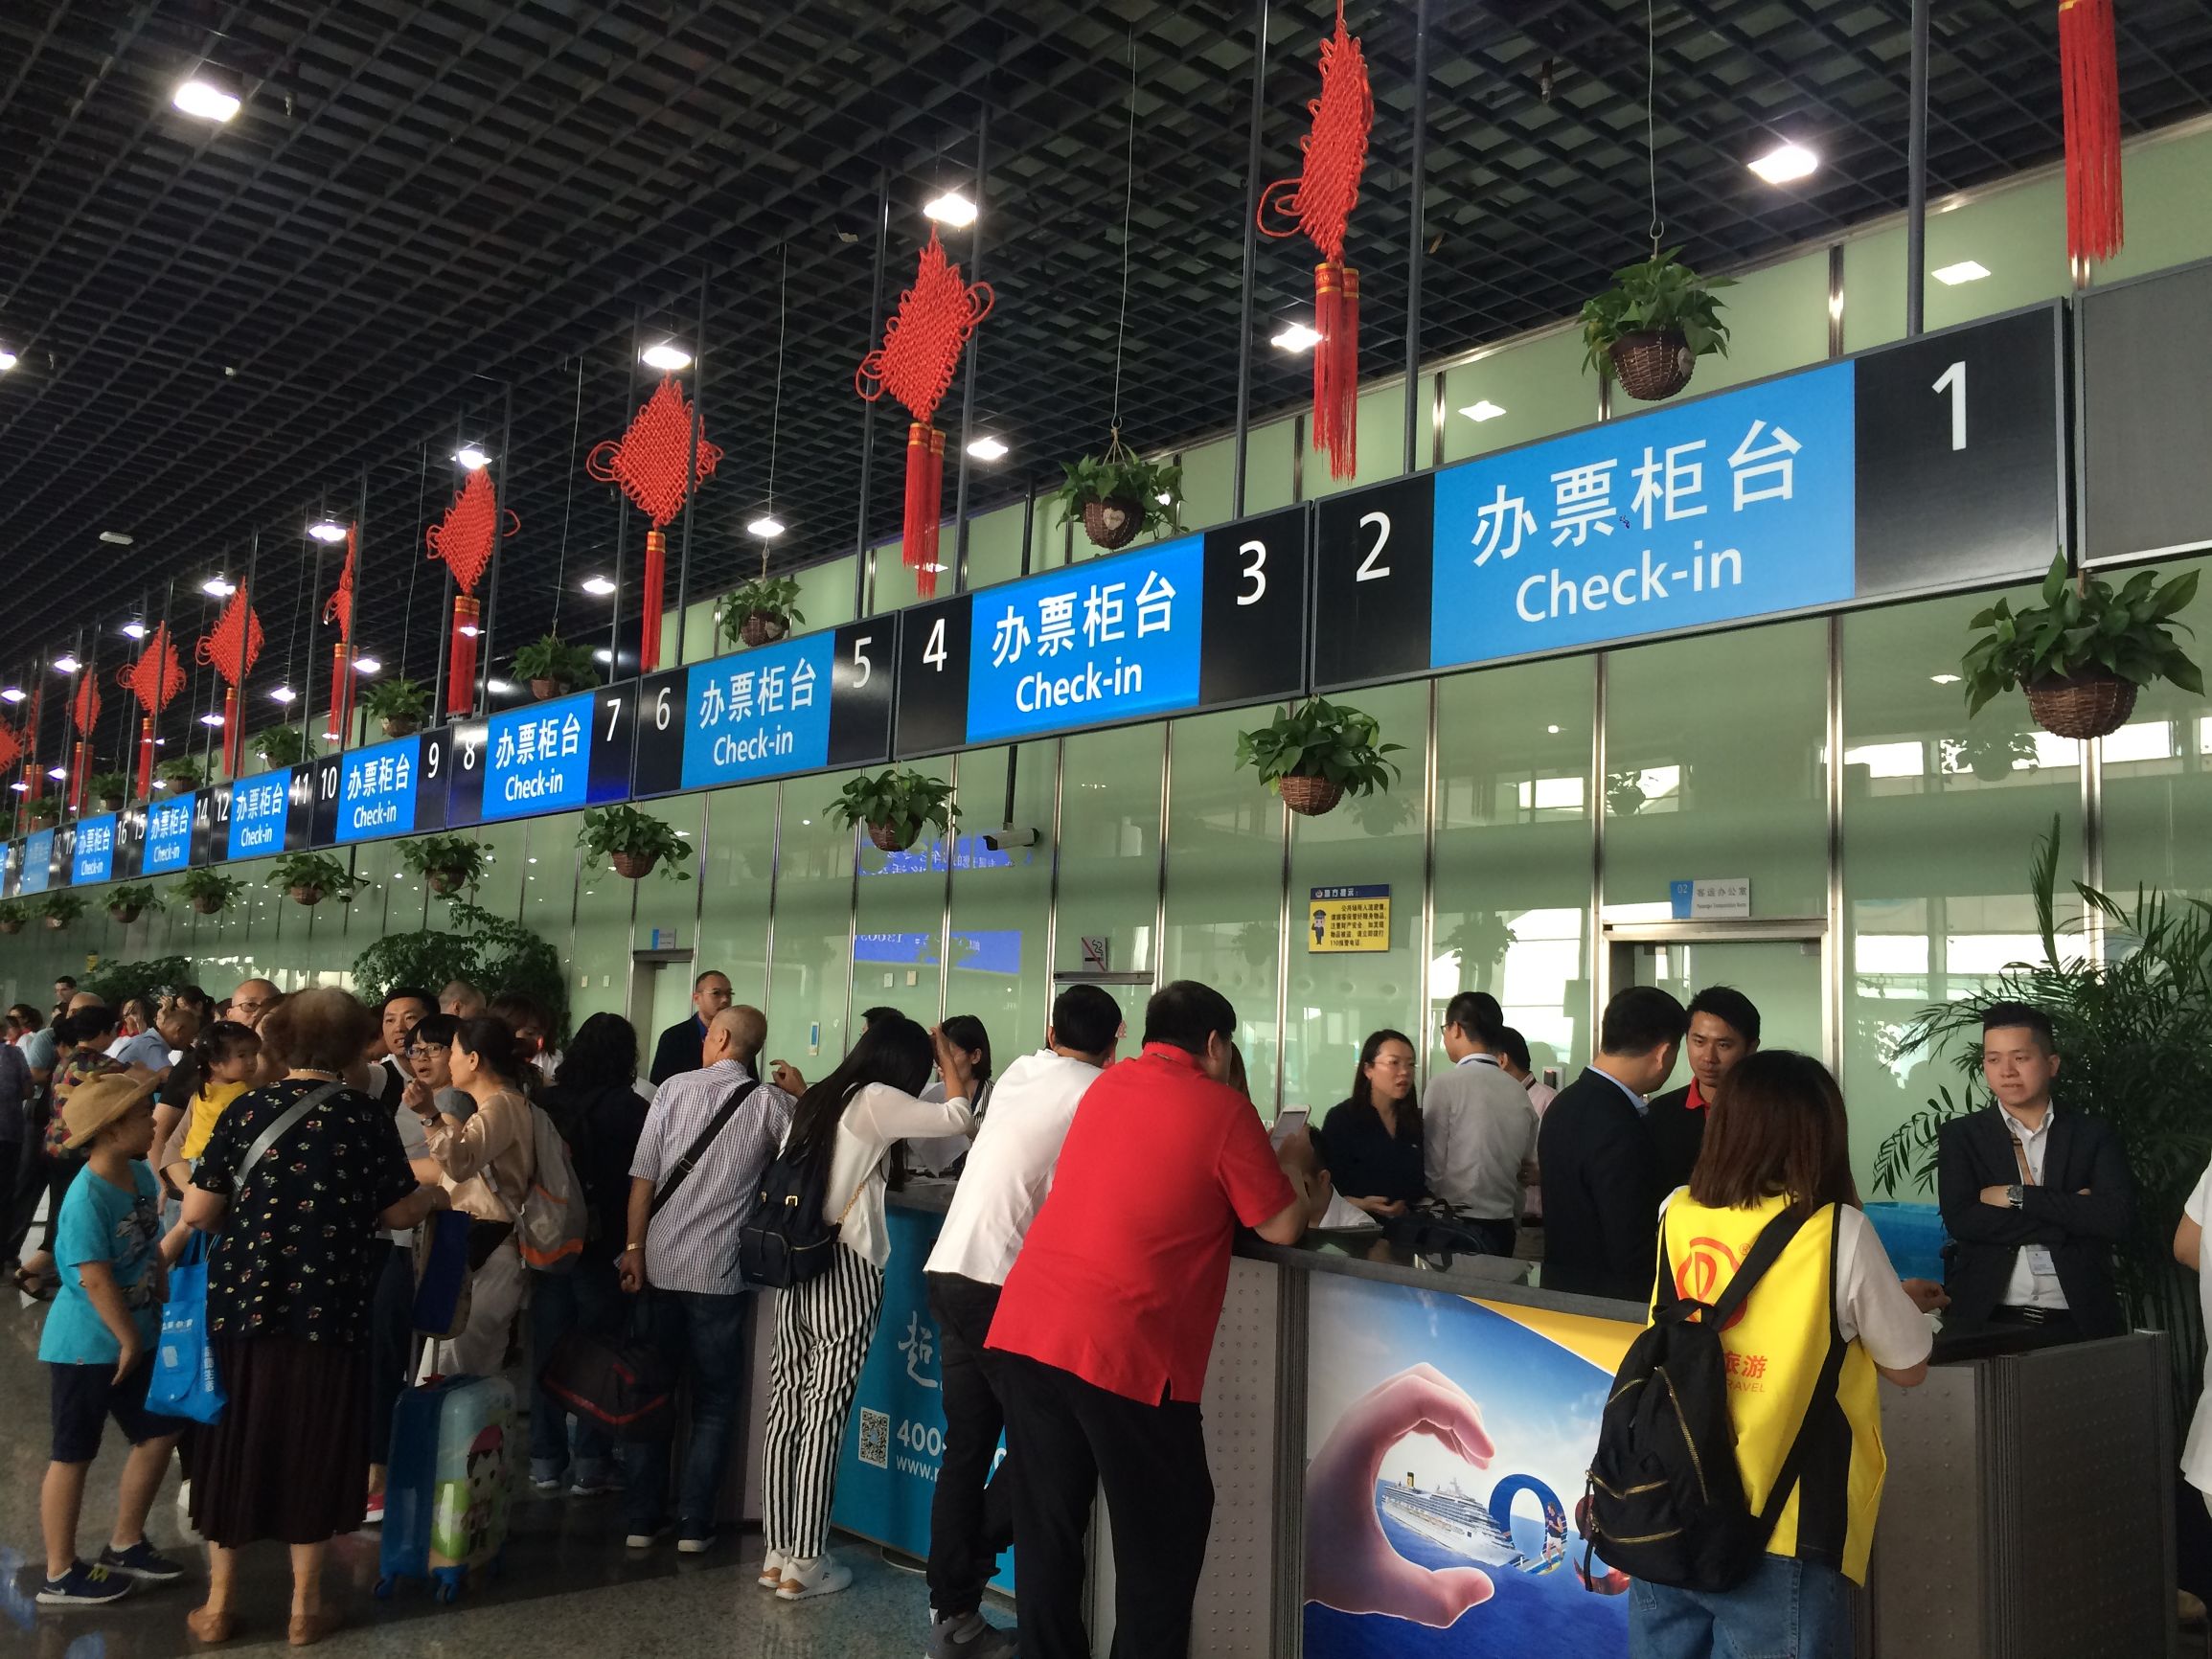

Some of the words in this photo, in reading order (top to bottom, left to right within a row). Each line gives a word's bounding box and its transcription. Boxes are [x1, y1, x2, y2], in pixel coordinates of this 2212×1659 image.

[1931, 360, 1967, 450] 1
[1471, 420, 1802, 567] 办票柜台
[1356, 511, 1390, 582] 2
[1237, 540, 1266, 605] 3
[1516, 539, 1744, 623] Check-in
[992, 571, 1176, 667] 办票柜台
[852, 637, 873, 689] 5
[923, 618, 947, 671] 4
[699, 658, 816, 729] 办票柜台
[1015, 656, 1142, 713] Check-in
[606, 697, 622, 742] 7
[655, 687, 672, 731] 6
[427, 741, 440, 779] 9
[464, 735, 476, 770] 8
[495, 713, 581, 769] 办票柜台
[714, 725, 793, 766] Check-in
[293, 772, 309, 807] 11
[321, 765, 337, 801] 10
[347, 753, 410, 801] 办票柜台
[505, 767, 563, 801] Check-in
[150, 806, 189, 840] 办票柜台
[196, 797, 210, 828] 14
[217, 791, 230, 823] 12
[236, 783, 284, 822] 办票柜台
[353, 804, 397, 829] Check-in
[117, 819, 128, 846] 16
[240, 824, 272, 848] Check-in
[153, 845, 180, 863] Check-in
